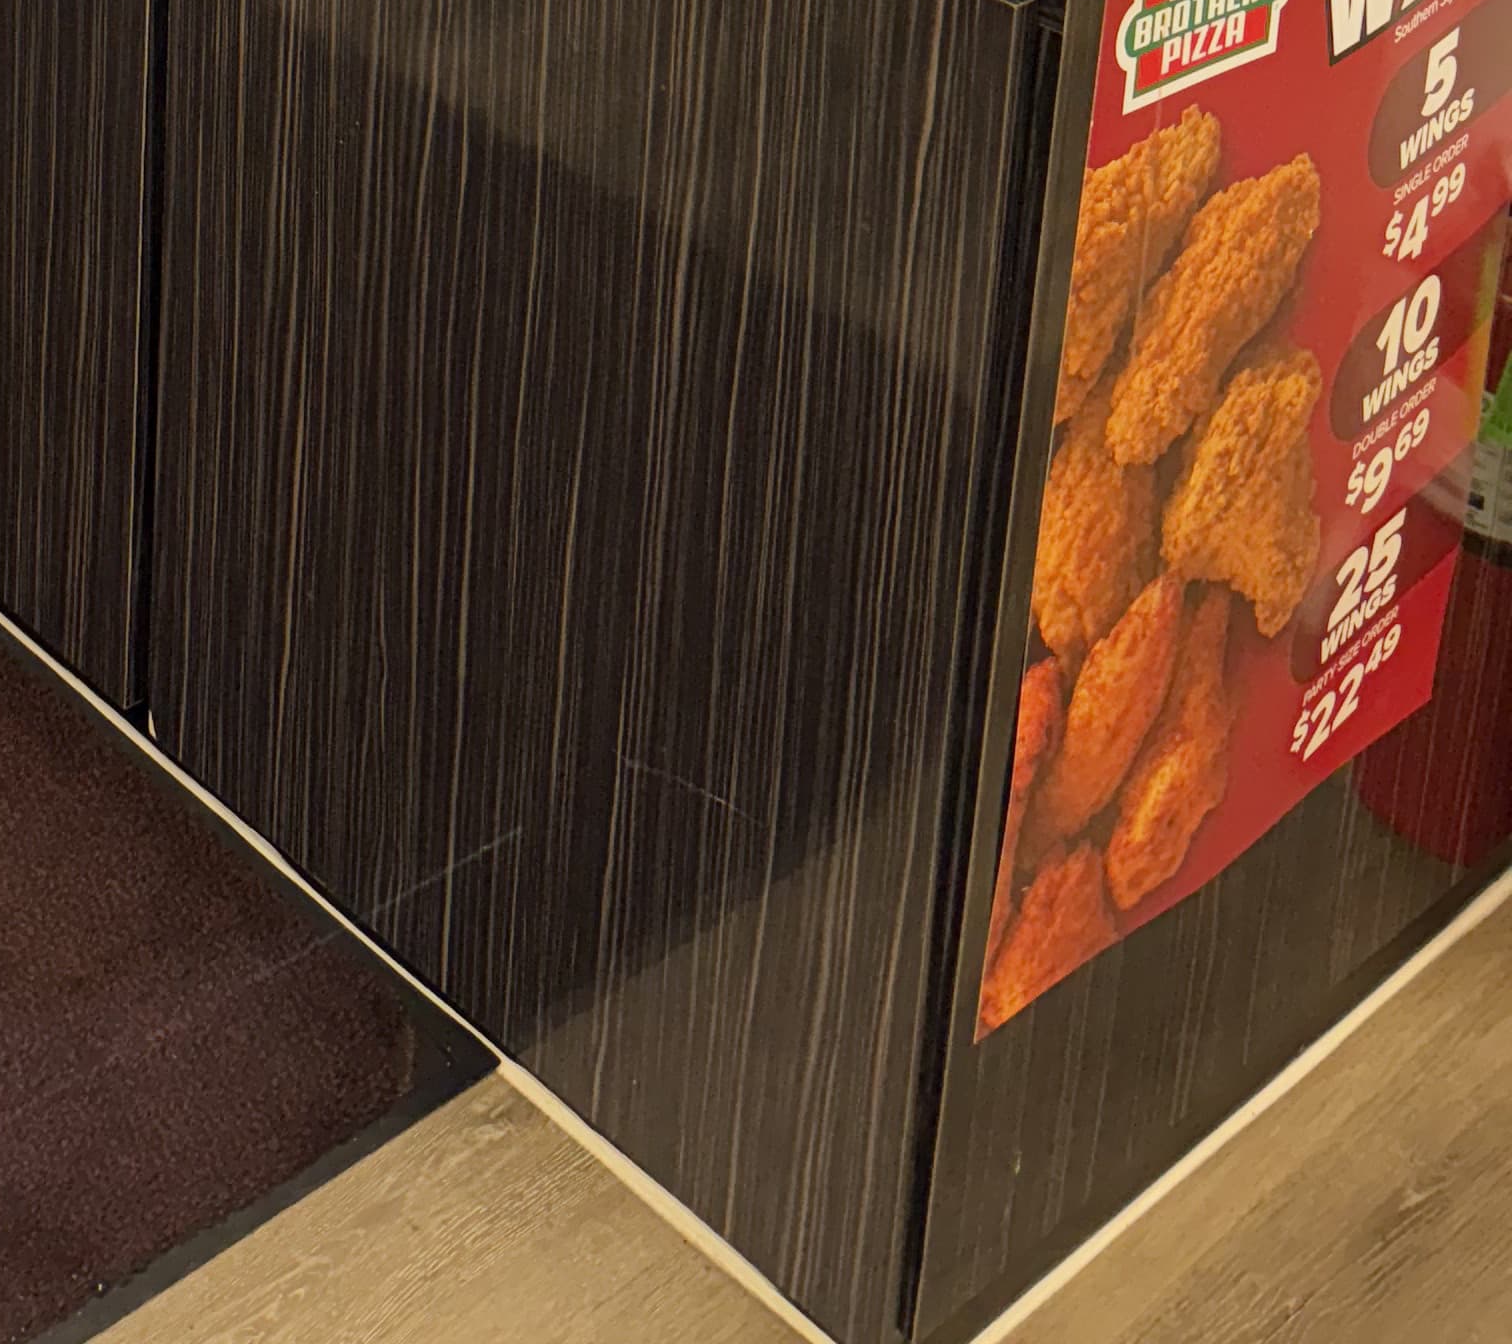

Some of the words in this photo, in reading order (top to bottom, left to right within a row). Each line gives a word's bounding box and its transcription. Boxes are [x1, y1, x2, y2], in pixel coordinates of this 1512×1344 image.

[1160, 10, 1246, 75] PIZZA
[1420, 26, 1460, 117] 5
[1393, 161, 1432, 205] SINGLE
[1432, 133, 1470, 173] ORDER
[1399, 88, 1475, 170] WINGS
[1375, 274, 1441, 376] 10
[1352, 410, 1399, 460] DOUBLE
[1399, 376, 1437, 419] ORDER
[1362, 336, 1440, 423] WINGS
[1327, 507, 1407, 632] 25
[1302, 664, 1338, 708] PARTY
[1337, 640, 1362, 672] SIZE
[1361, 604, 1400, 647] ORDER
[1321, 574, 1398, 664] WINGS
